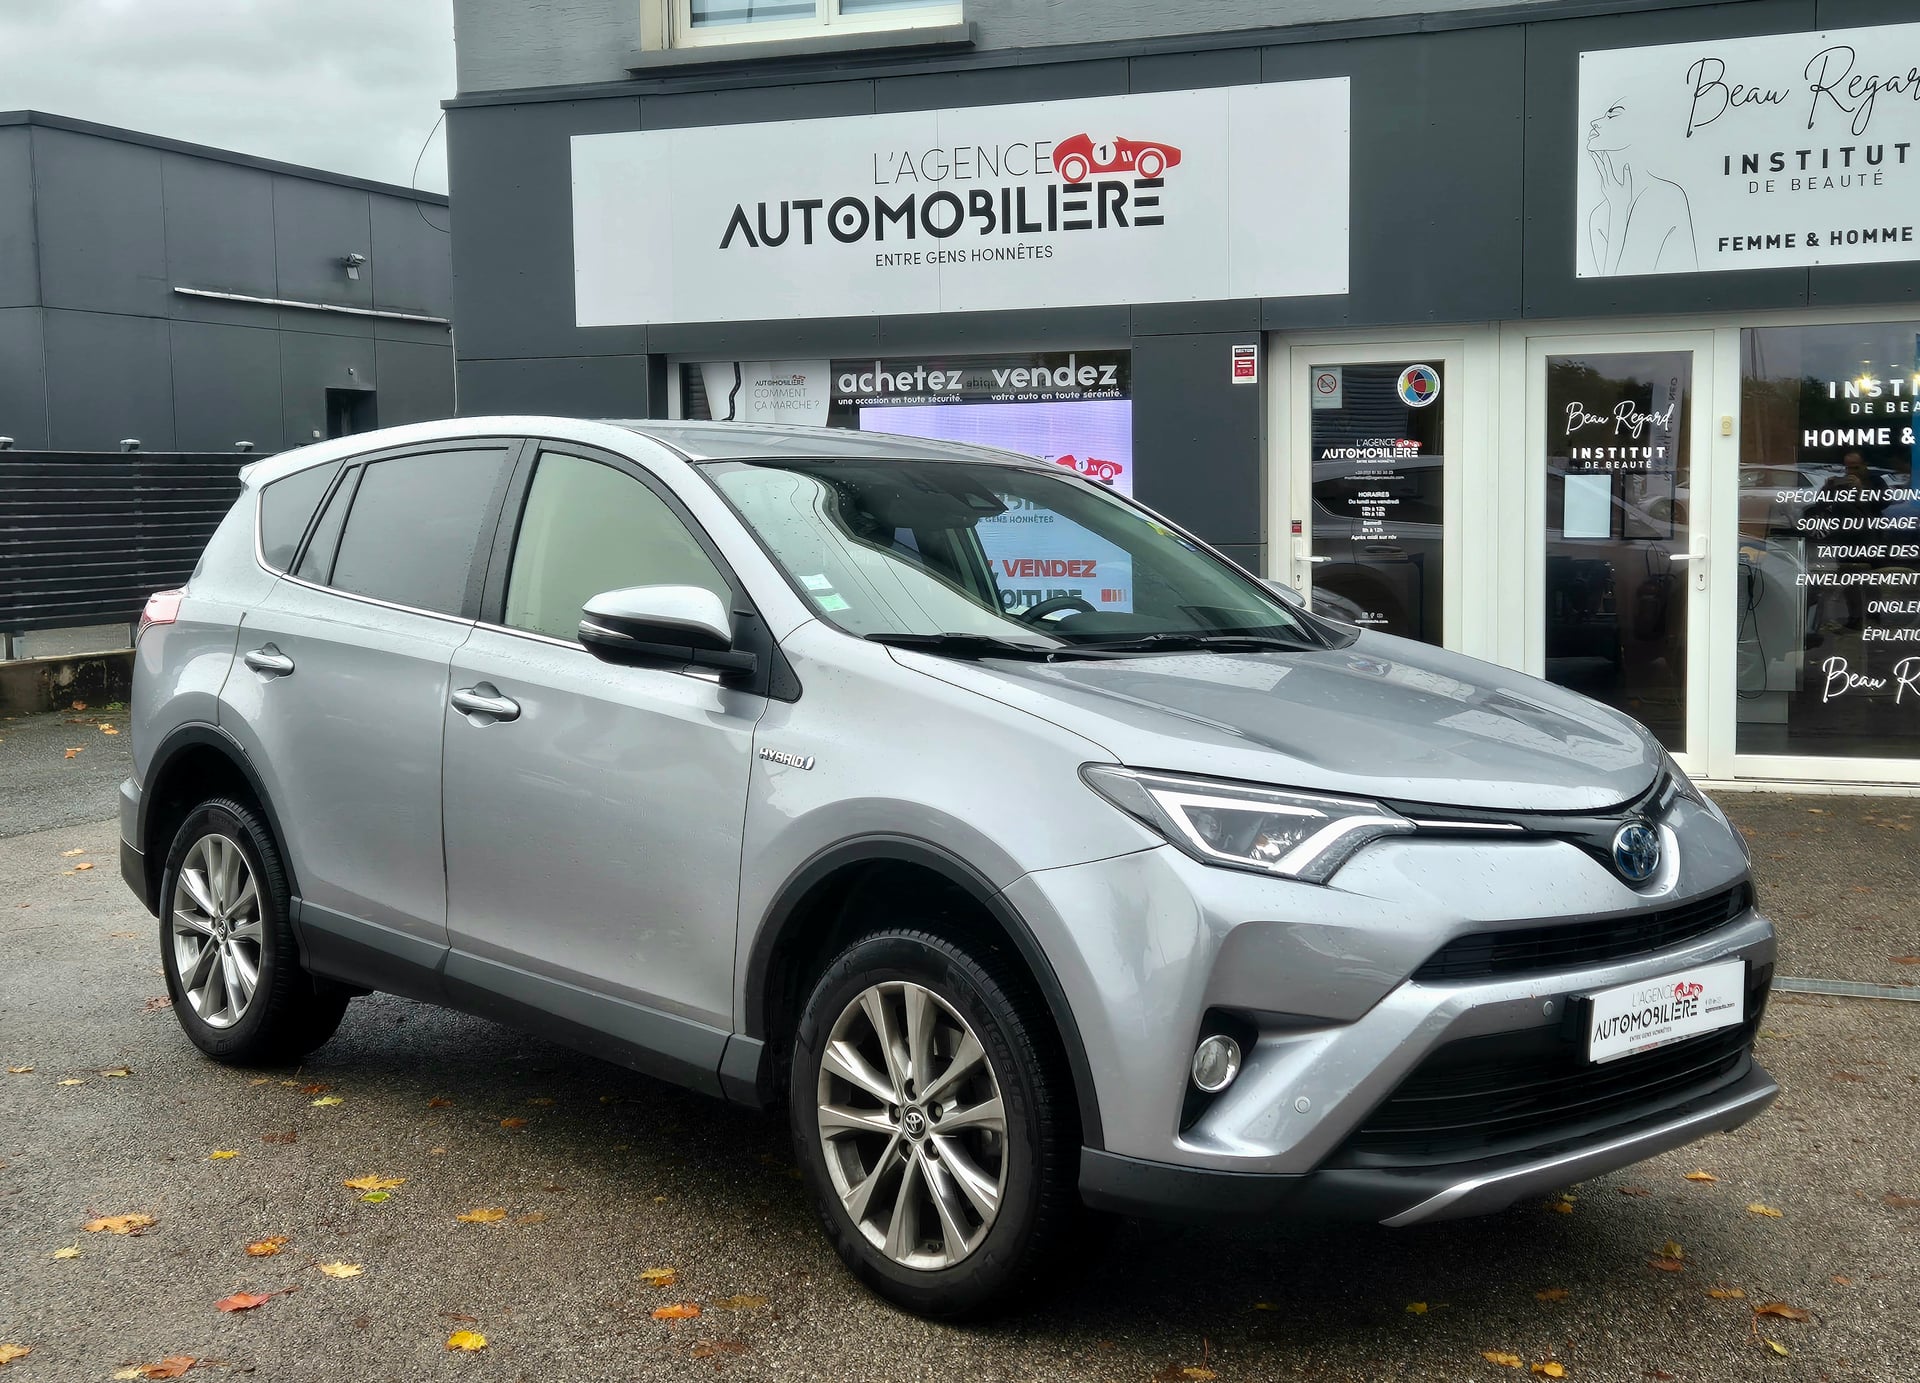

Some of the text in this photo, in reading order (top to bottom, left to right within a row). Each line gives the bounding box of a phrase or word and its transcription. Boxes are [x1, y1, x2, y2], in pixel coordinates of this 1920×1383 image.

[1686, 56, 1789, 138] Beau
[1723, 142, 1911, 176] INSTITUT
[1748, 168, 1884, 194] DE BEAUTÉ
[1718, 226, 1913, 252] FEMME & HOMME
[875, 242, 1054, 268] ENTRE GENS HONNÊTES
[838, 353, 1118, 393] achetez vendez
[754, 387, 807, 399] COMMENT
[991, 388, 1123, 401] votre auto en toute sérénité.
[1829, 379, 1920, 399] INSTI
[754, 400, 768, 412] ÇA
[769, 399, 812, 410] MARCHE
[838, 397, 853, 405] une
[855, 395, 889, 405] occasion
[891, 396, 901, 404] en
[903, 395, 926, 404] toute
[1850, 402, 1874, 415] DE
[1565, 400, 1675, 439] Beau Regard
[1803, 427, 1916, 447] HOMME &
[1572, 446, 1666, 460] INSTITUT
[1584, 458, 1652, 469] DE BEAUTÉ
[1775, 487, 1857, 503] SPÉCIALISÉ
[1860, 489, 1881, 502] EN
[1796, 516, 1917, 531] SOINS DU VISAGE
[1817, 544, 1920, 559] TATOUAGE DES
[1002, 558, 1097, 578] VENDEZ
[1795, 572, 1920, 586] ENVELOPPEMENT
[1822, 656, 1887, 704] Beau
[759, 747, 806, 769] HYBRID
